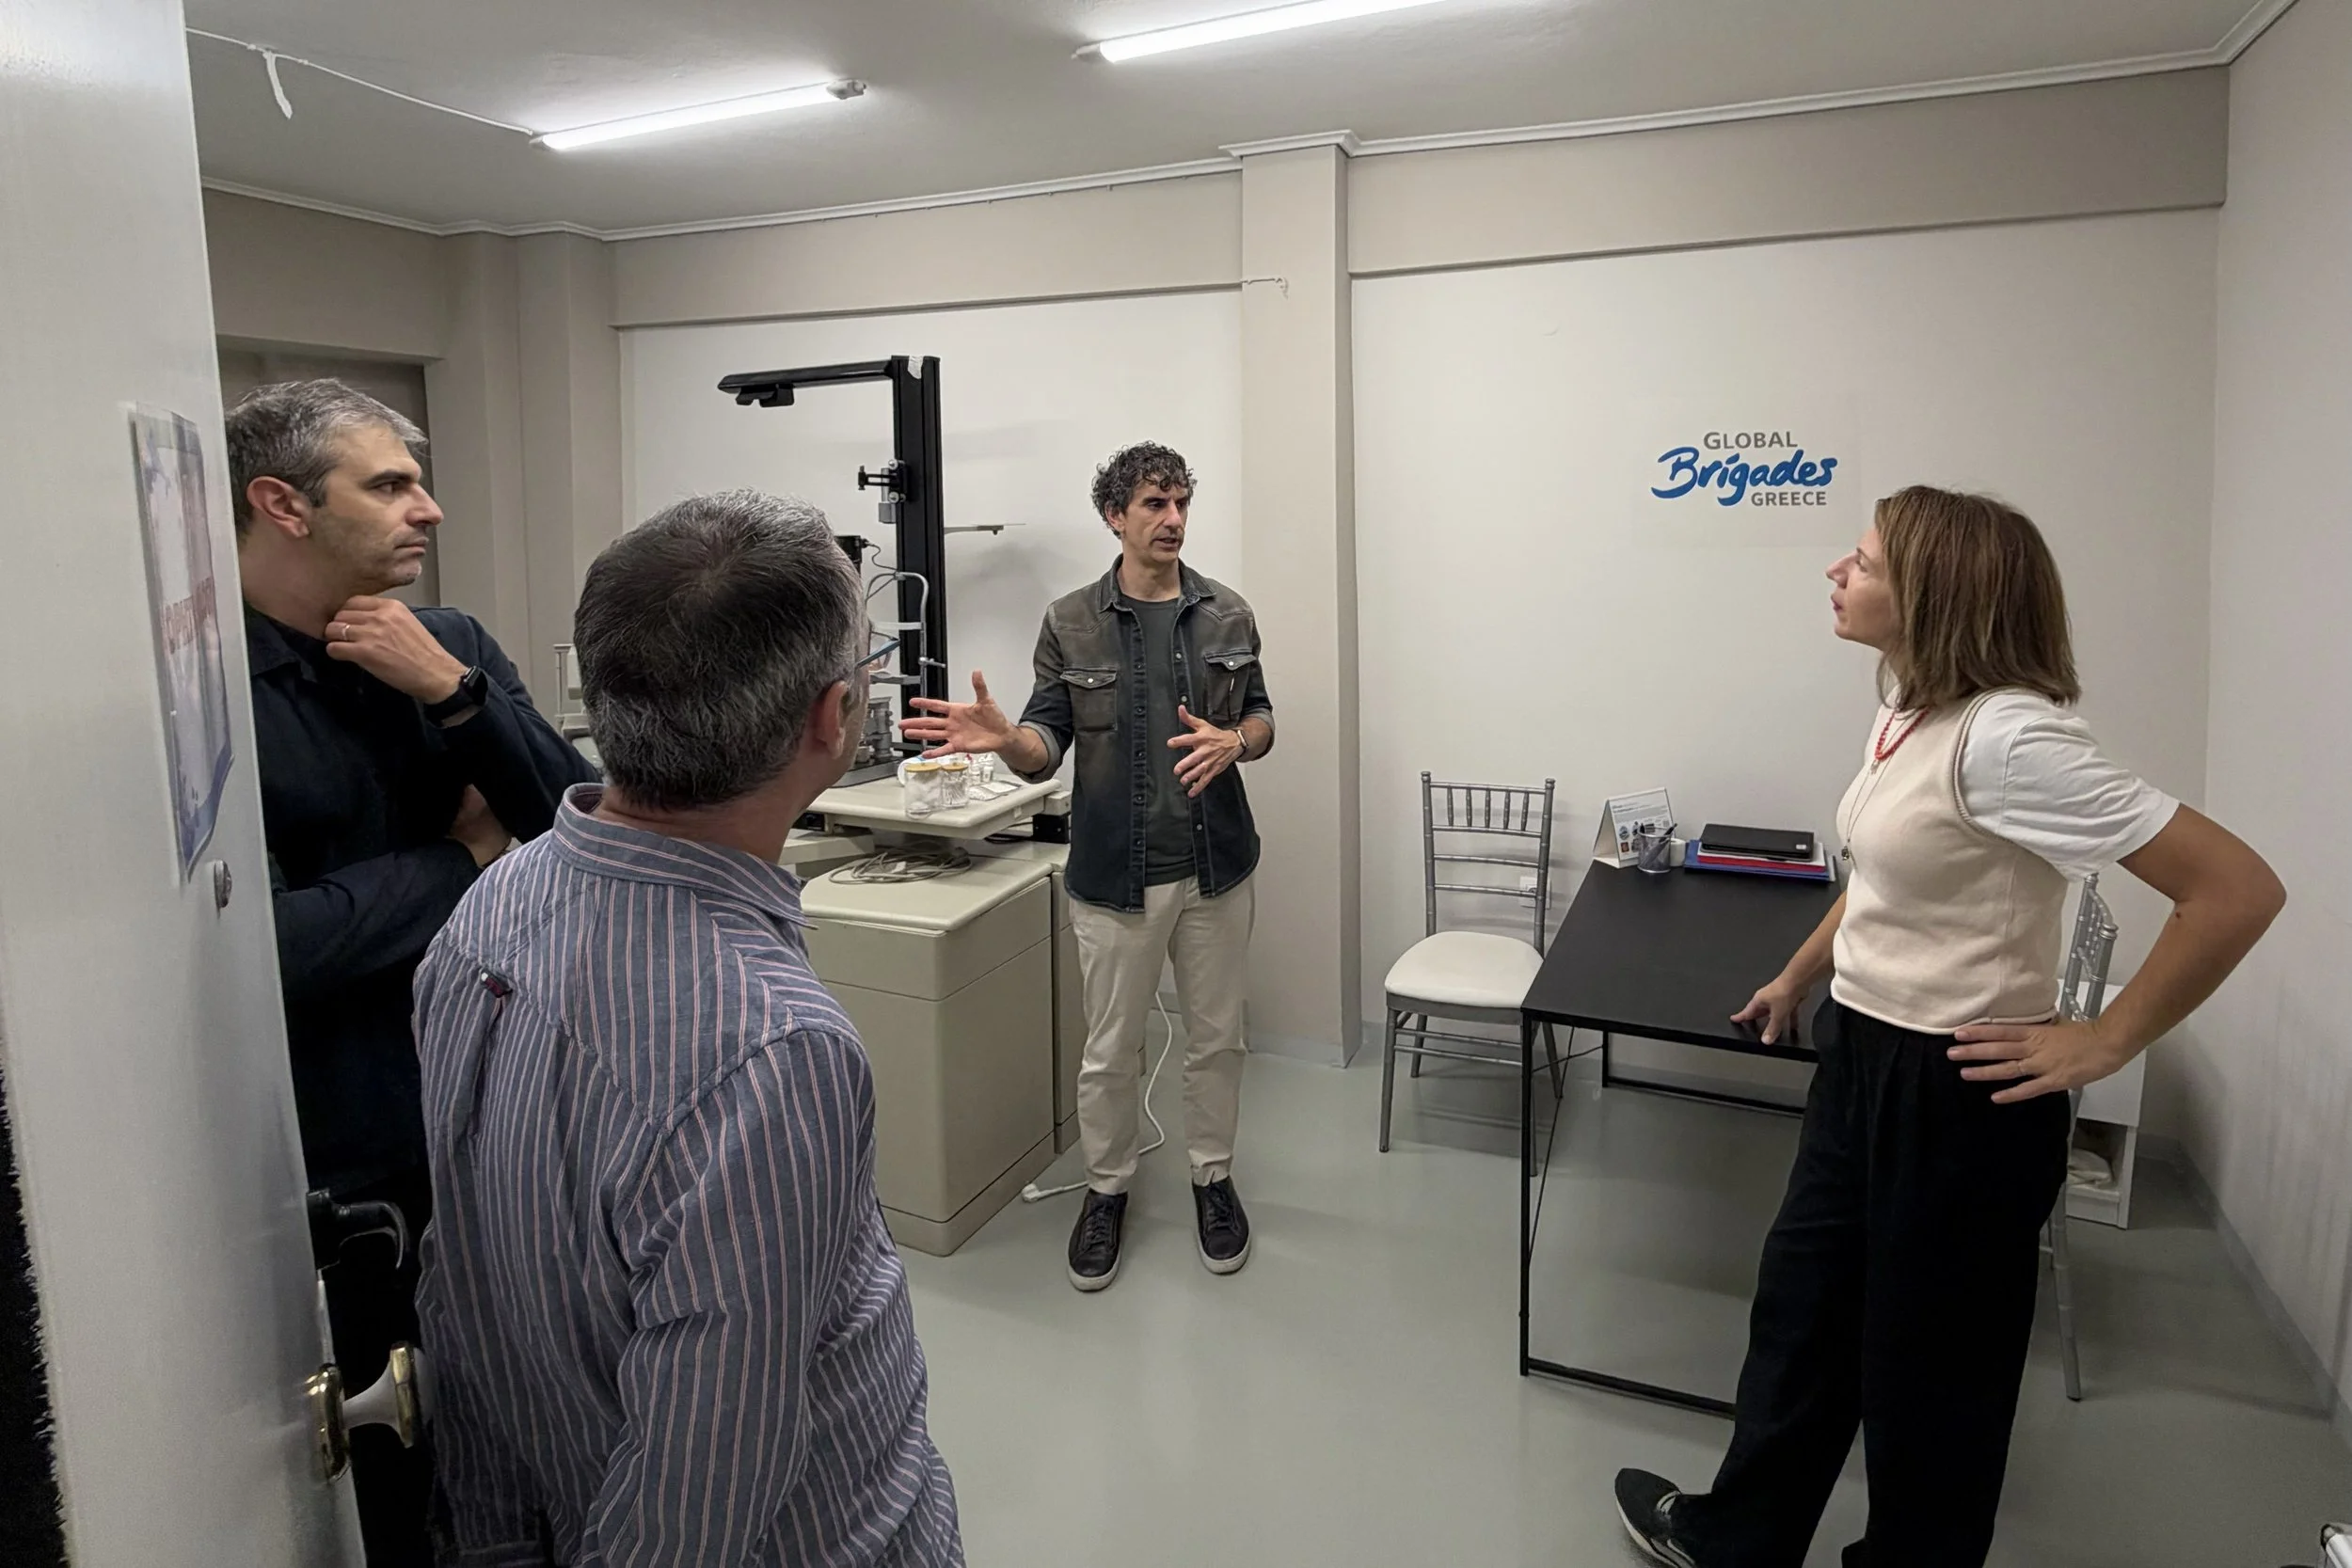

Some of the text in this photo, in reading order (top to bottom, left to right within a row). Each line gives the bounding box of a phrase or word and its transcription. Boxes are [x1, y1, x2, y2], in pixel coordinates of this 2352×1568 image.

[1703, 431, 1798, 450] GLOBAL
[1651, 447, 1837, 506] Brigades
[1751, 491, 1827, 506] GREECE
